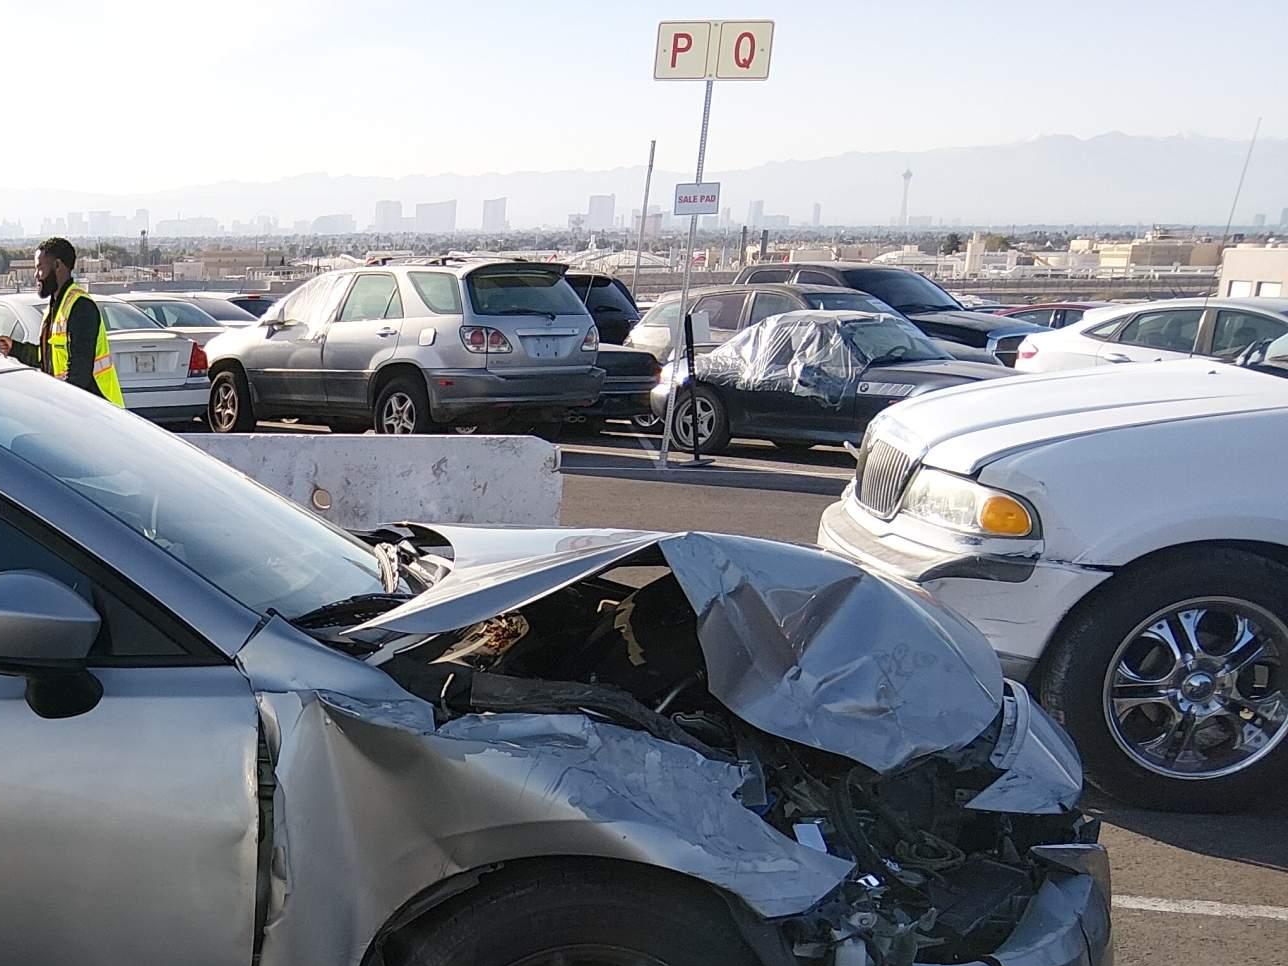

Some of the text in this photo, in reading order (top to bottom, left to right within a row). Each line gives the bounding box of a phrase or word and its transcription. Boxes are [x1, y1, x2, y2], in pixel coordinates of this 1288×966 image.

[670, 32, 756, 69] P Q
[677, 194, 716, 204] SALE PAD
